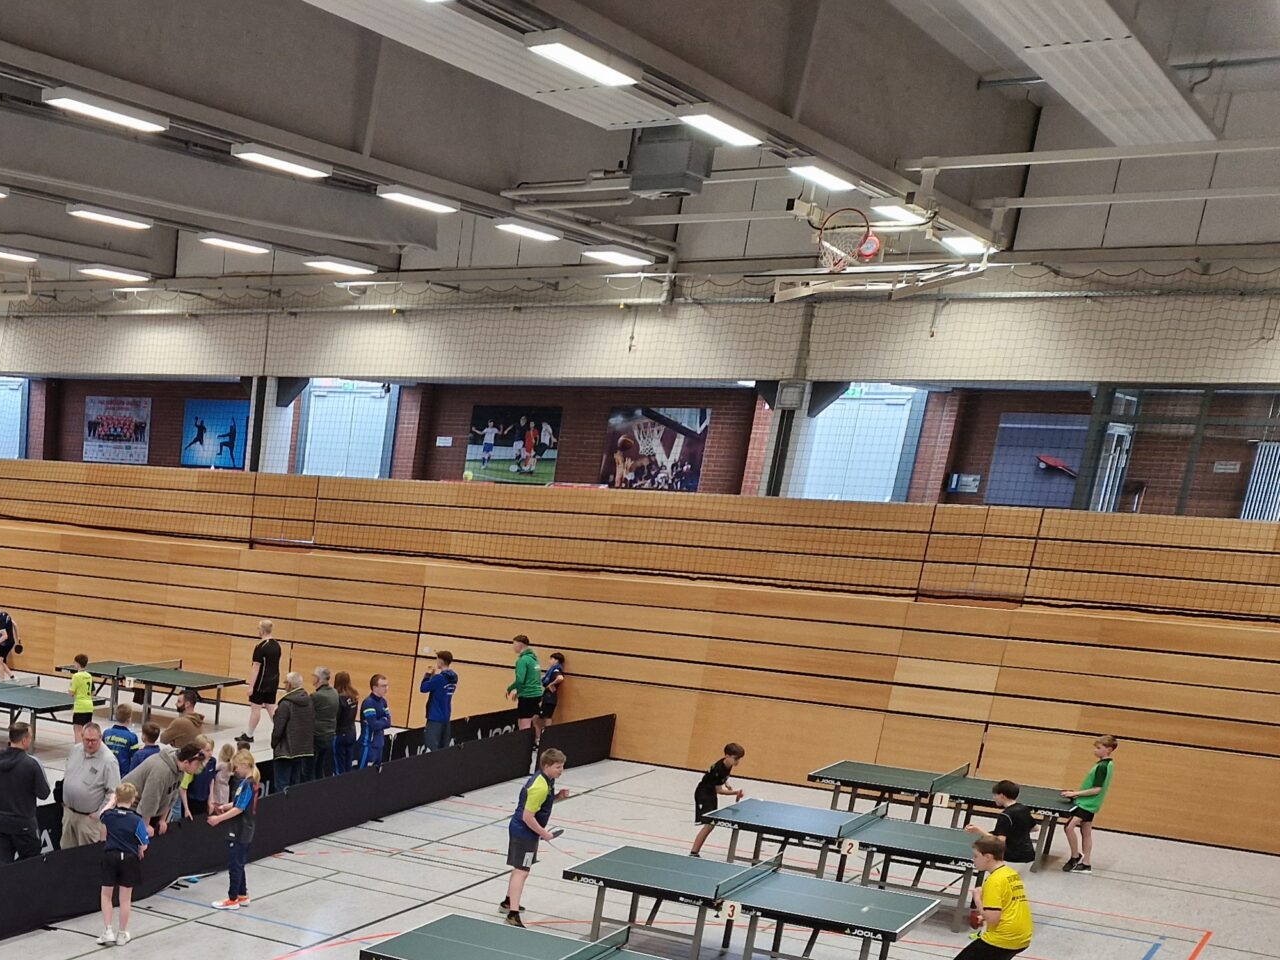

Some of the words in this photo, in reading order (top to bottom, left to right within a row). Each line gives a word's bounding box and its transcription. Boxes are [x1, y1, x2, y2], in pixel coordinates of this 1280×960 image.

[847, 843, 854, 855] 2
[579, 876, 604, 886] JOOLA
[727, 904, 736, 919] 3
[852, 928, 883, 940] JOOLA
